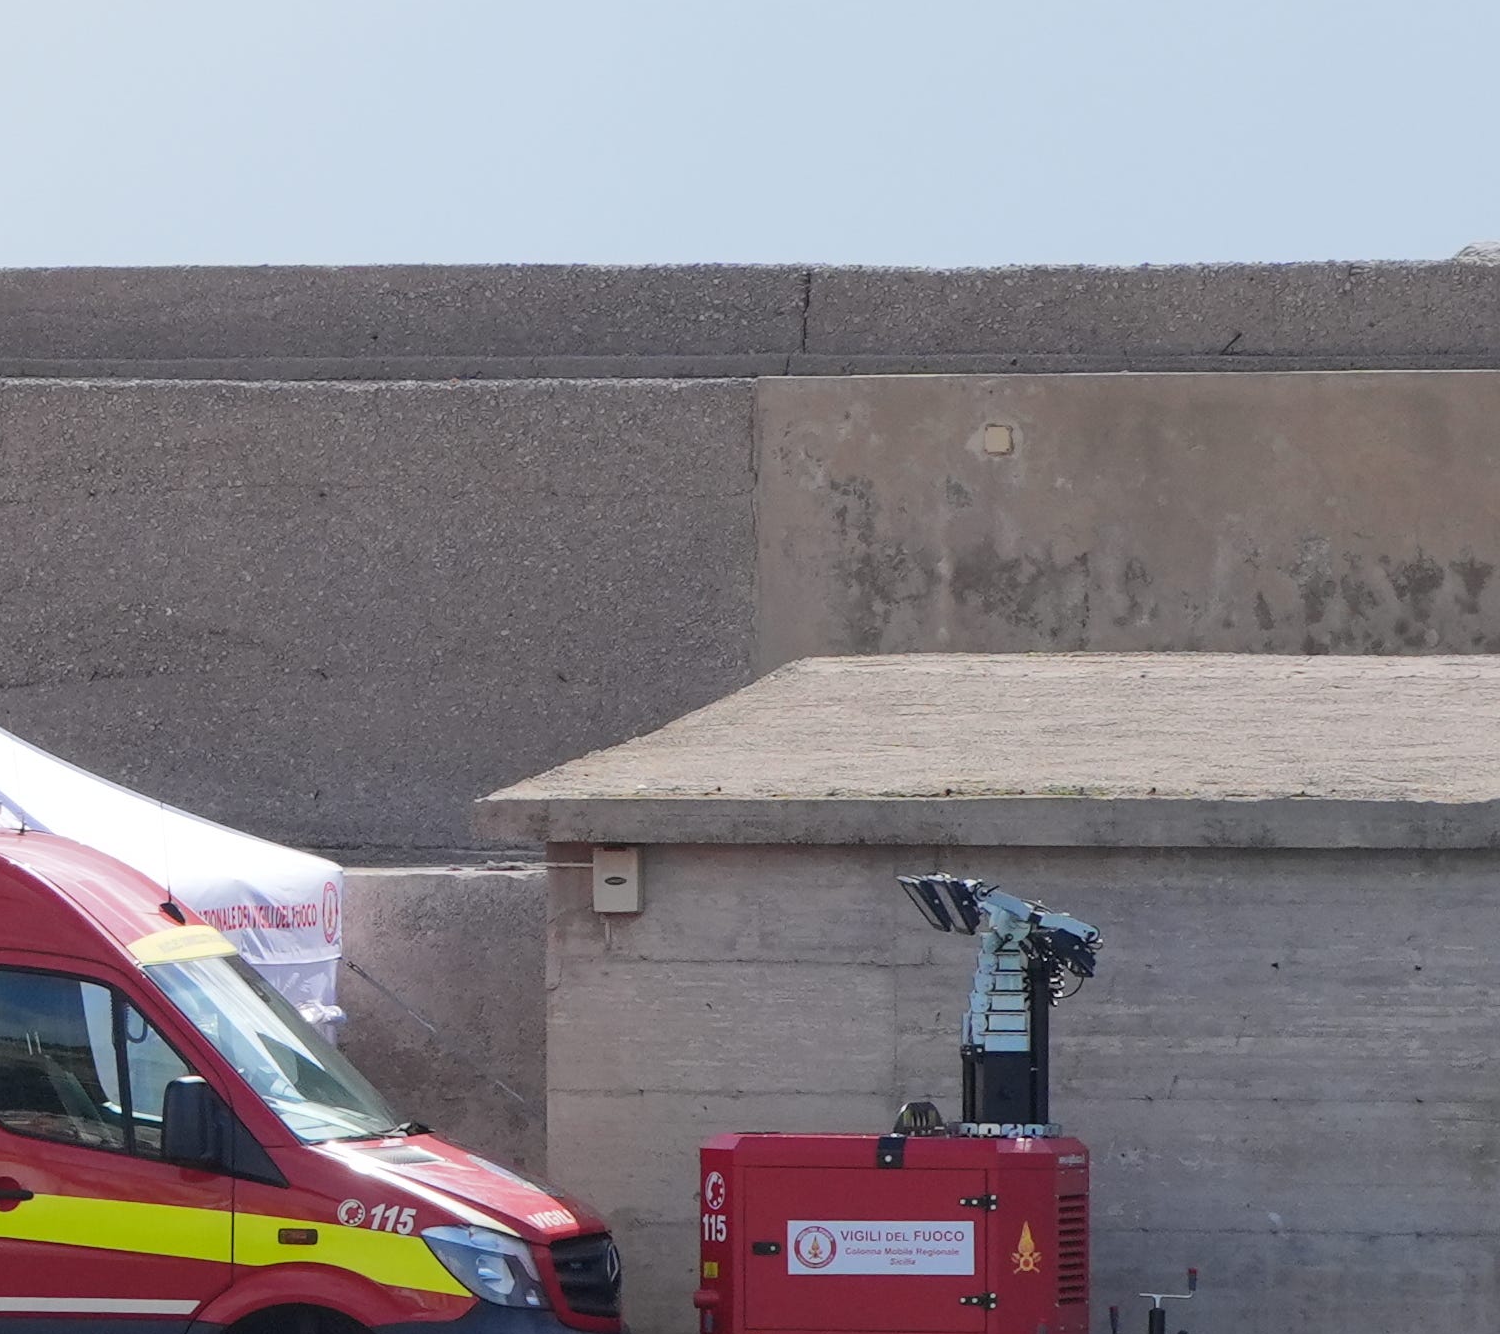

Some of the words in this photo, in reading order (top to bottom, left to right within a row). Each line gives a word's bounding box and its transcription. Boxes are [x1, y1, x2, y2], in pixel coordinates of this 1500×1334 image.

[369, 1203, 417, 1236] 115
[702, 1213, 727, 1243] 115
[840, 1230, 882, 1242] VIGILI
[885, 1232, 909, 1242] DEL
[913, 1230, 965, 1242] FUOCO
[844, 1247, 881, 1256] Colonna
[884, 1247, 913, 1256] Mobile
[916, 1247, 960, 1257] Regionale
